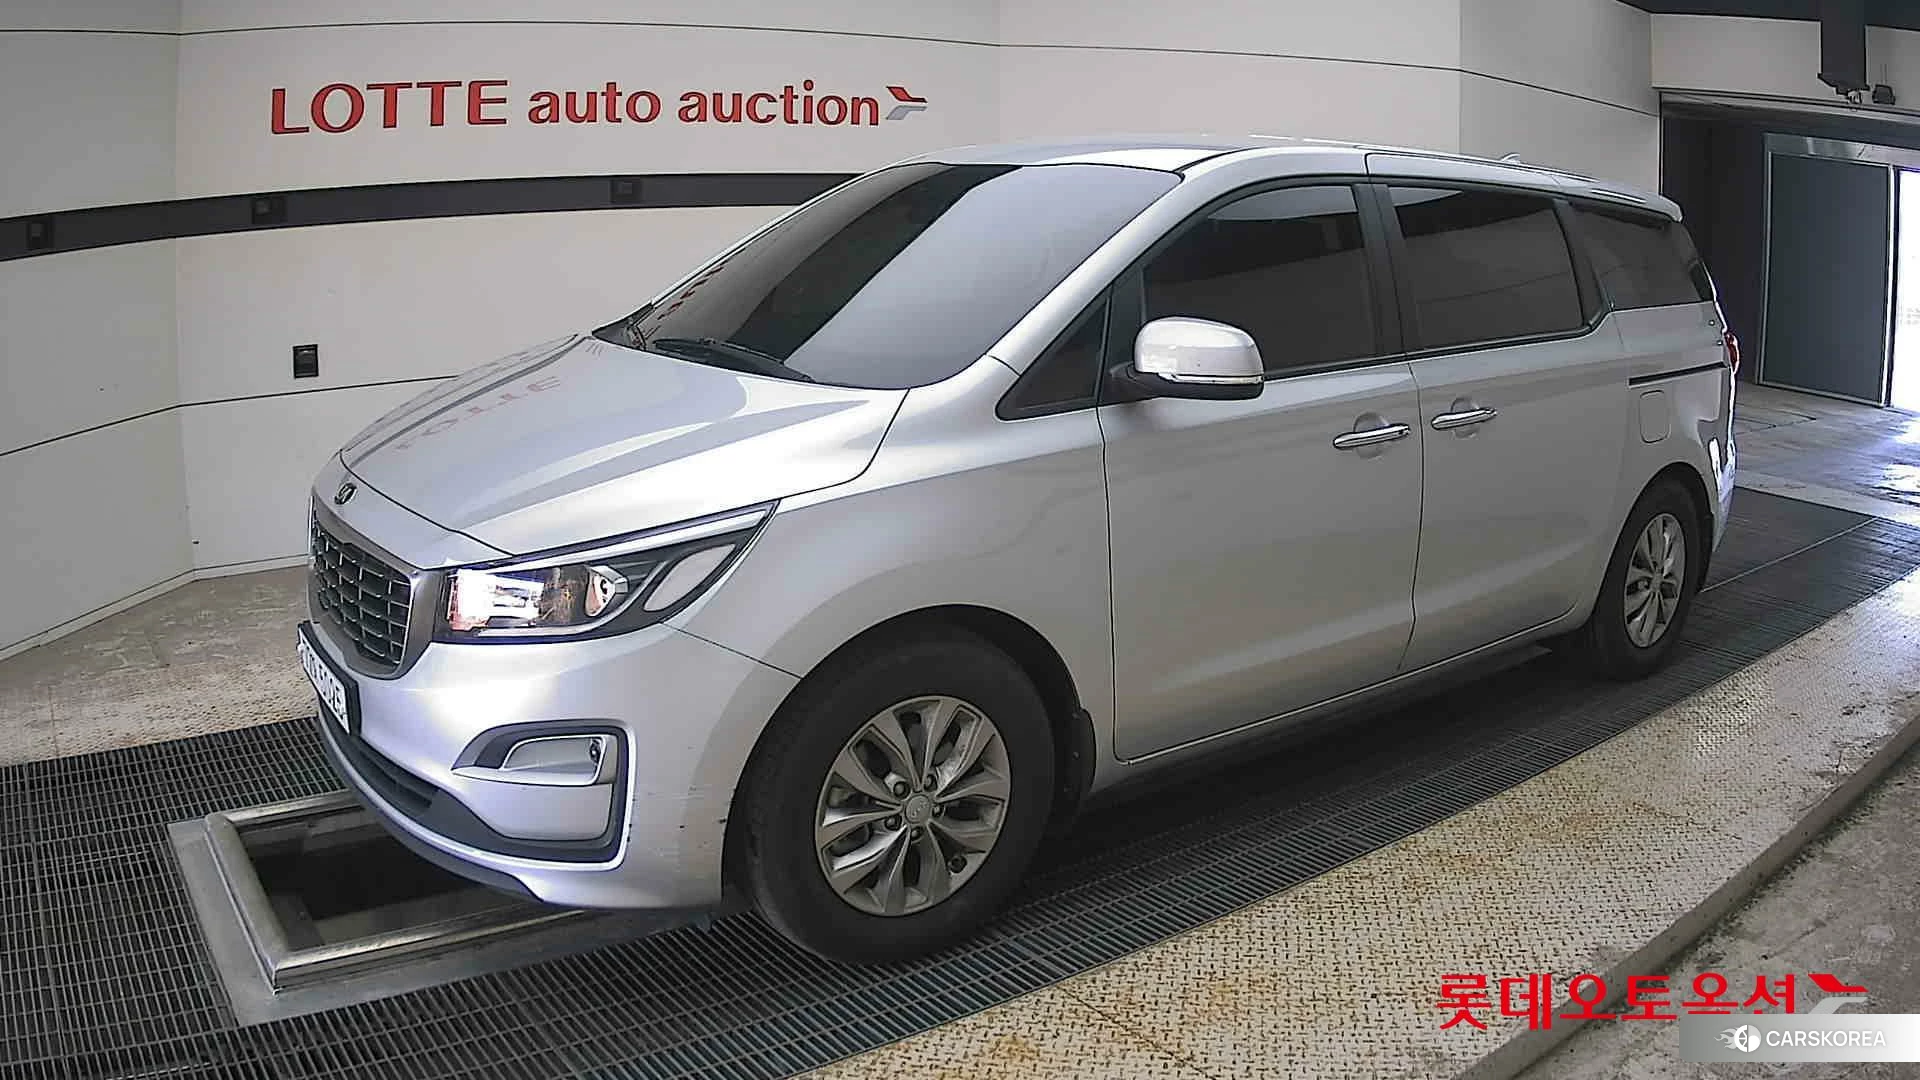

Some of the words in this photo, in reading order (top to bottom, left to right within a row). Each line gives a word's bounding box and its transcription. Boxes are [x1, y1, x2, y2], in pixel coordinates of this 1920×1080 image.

[271, 80, 508, 134] LOTTE
[528, 83, 662, 125] auto
[678, 80, 880, 126] auction
